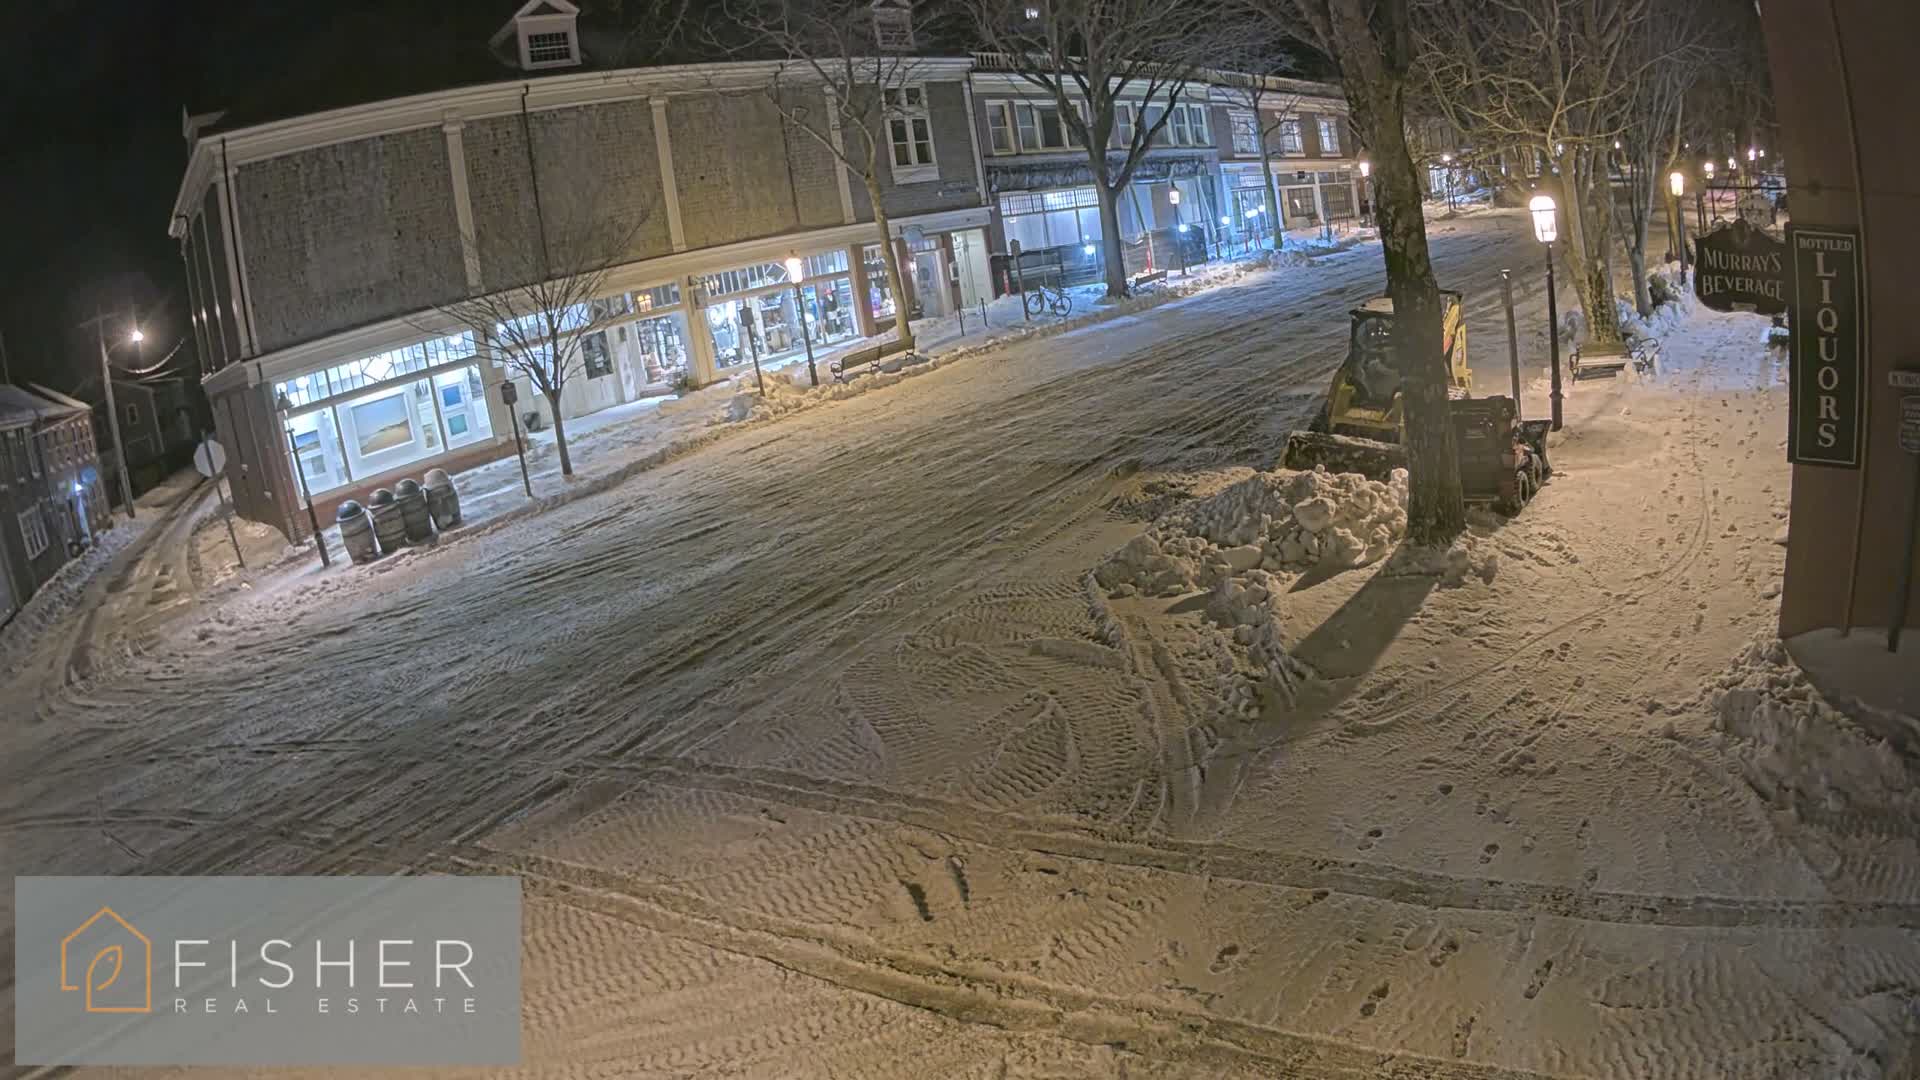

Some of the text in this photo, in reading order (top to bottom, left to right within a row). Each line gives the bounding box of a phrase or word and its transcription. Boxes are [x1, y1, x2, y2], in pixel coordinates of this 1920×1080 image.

[1799, 238, 1852, 251] BOTTLED
[1703, 247, 1782, 273] MURRAY'S
[1702, 274, 1784, 302] BEVERAGE
[1815, 251, 1841, 448] LIQUORS
